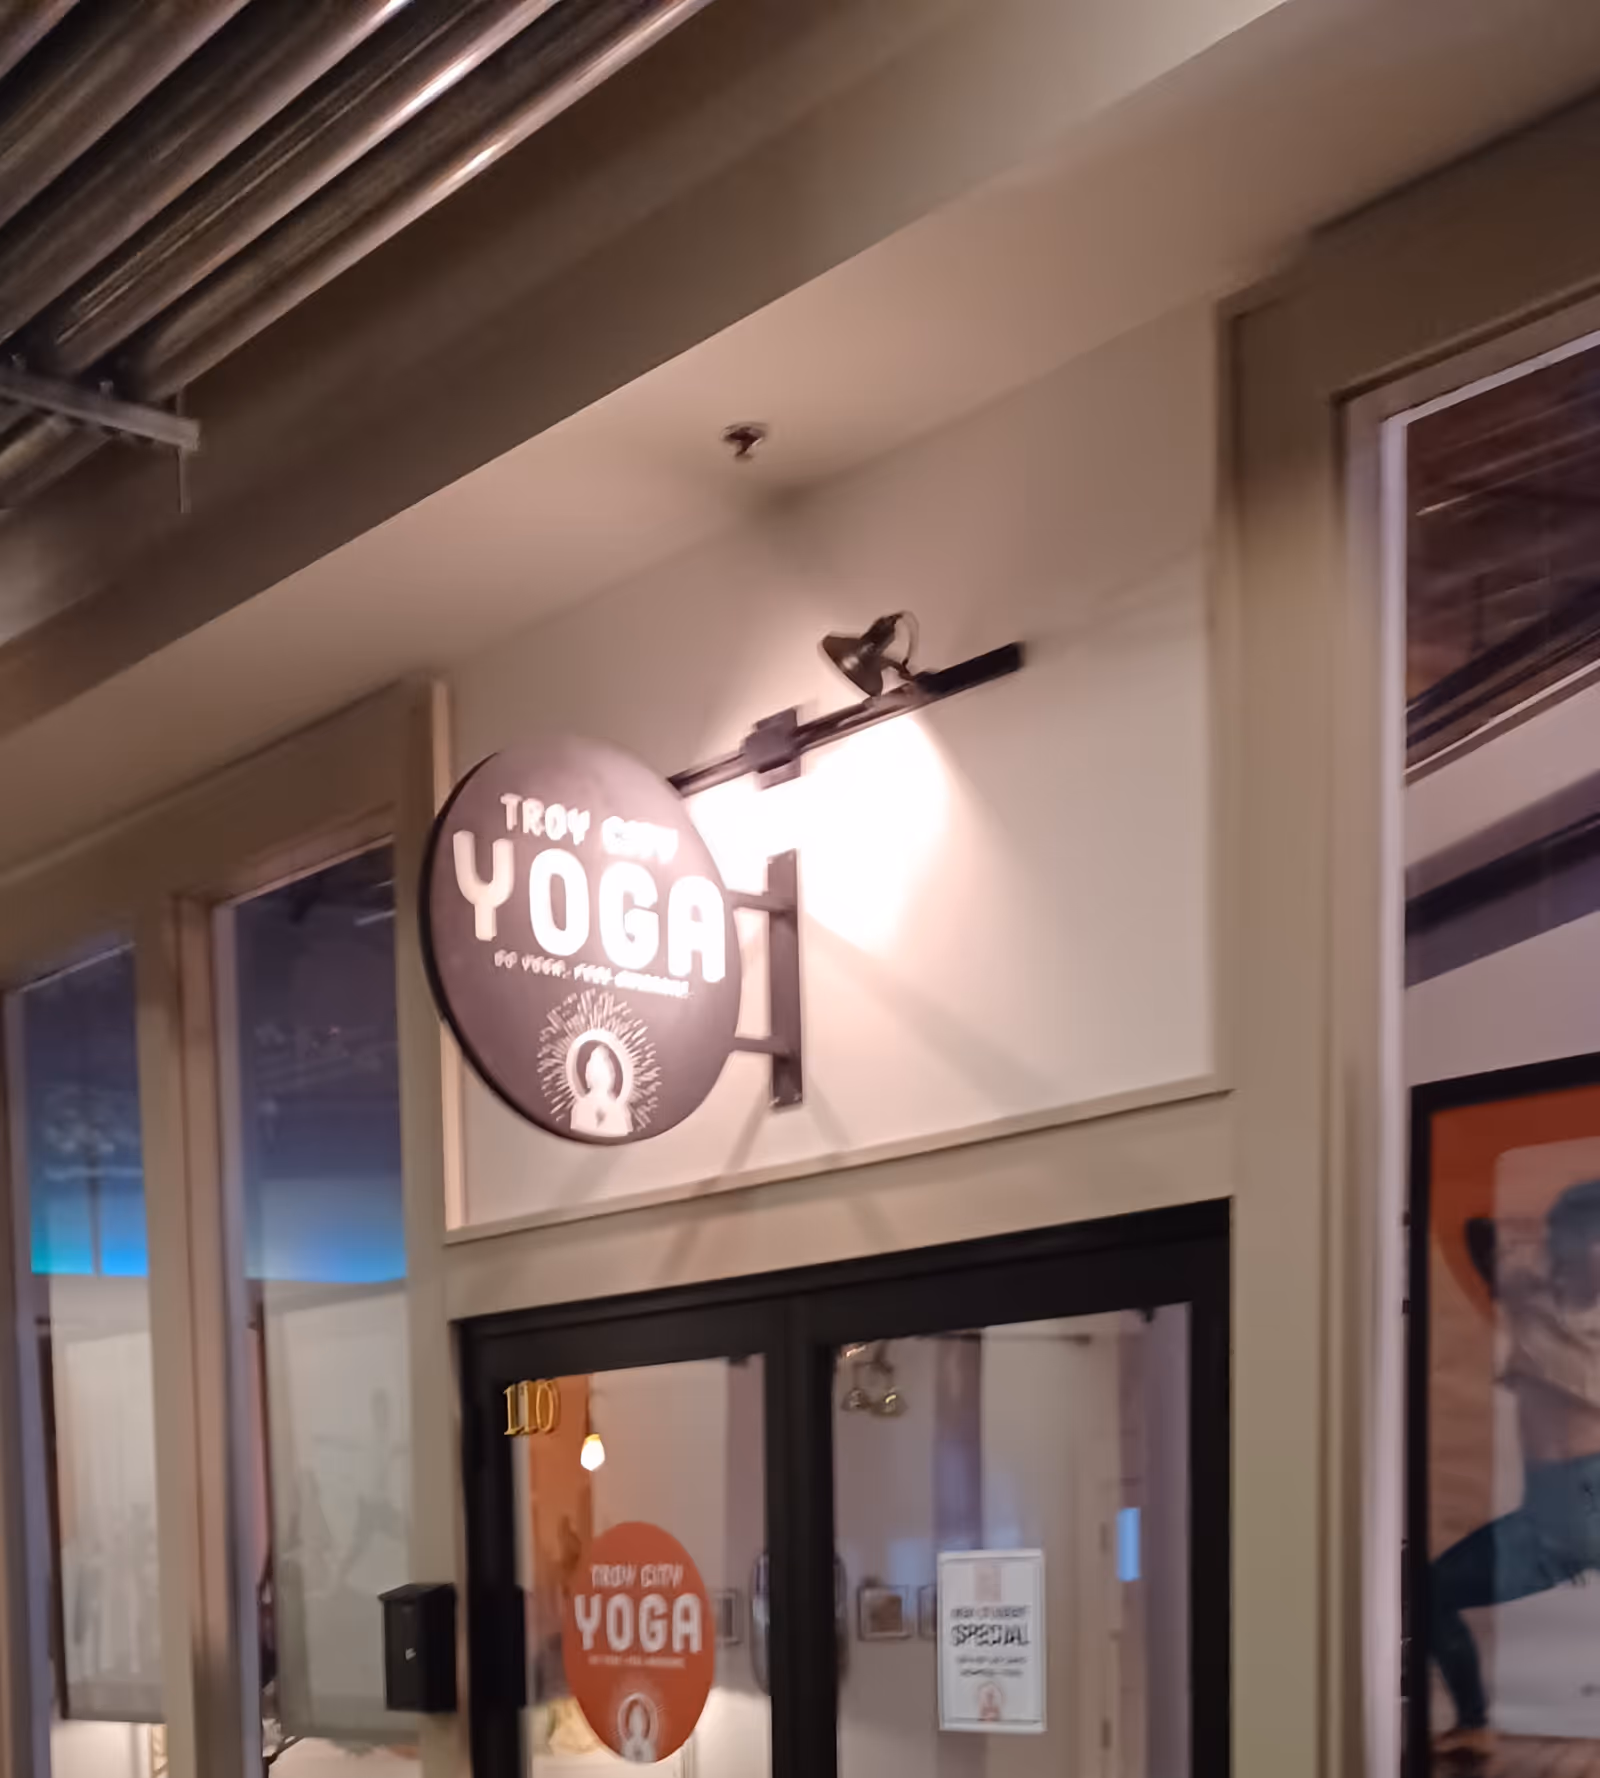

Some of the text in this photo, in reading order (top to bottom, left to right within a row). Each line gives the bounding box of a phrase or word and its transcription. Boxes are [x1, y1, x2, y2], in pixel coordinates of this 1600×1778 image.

[500, 793, 590, 845] TROY
[453, 830, 725, 983] YOGA
[503, 1379, 560, 1436] 110
[591, 1563, 684, 1588] TROY CITY
[574, 1593, 703, 1653] YOGA
[952, 1623, 1030, 1647] SPECIAL
